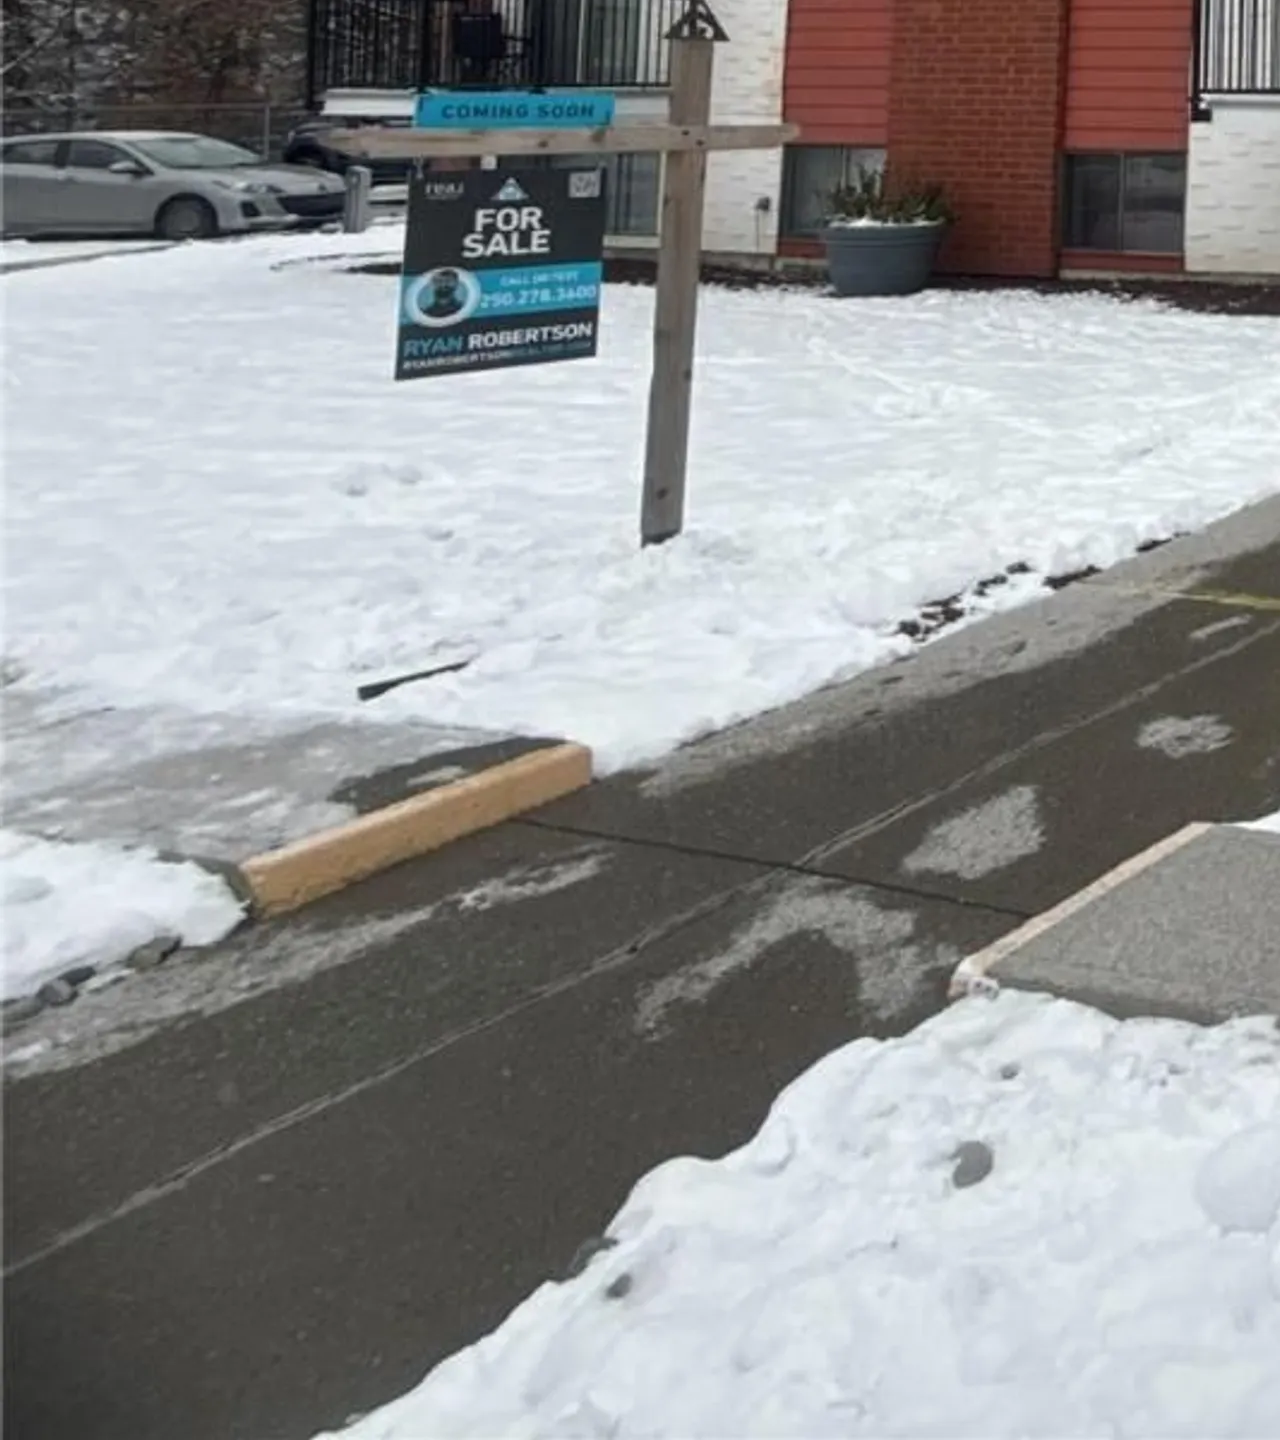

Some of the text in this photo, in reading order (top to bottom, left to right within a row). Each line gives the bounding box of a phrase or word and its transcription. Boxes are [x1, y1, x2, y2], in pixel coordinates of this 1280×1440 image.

[441, 102, 596, 120] COMING SOON
[474, 206, 543, 232] FOR
[461, 229, 551, 258] SALE
[403, 321, 593, 358] RYAN ROBERTSON
